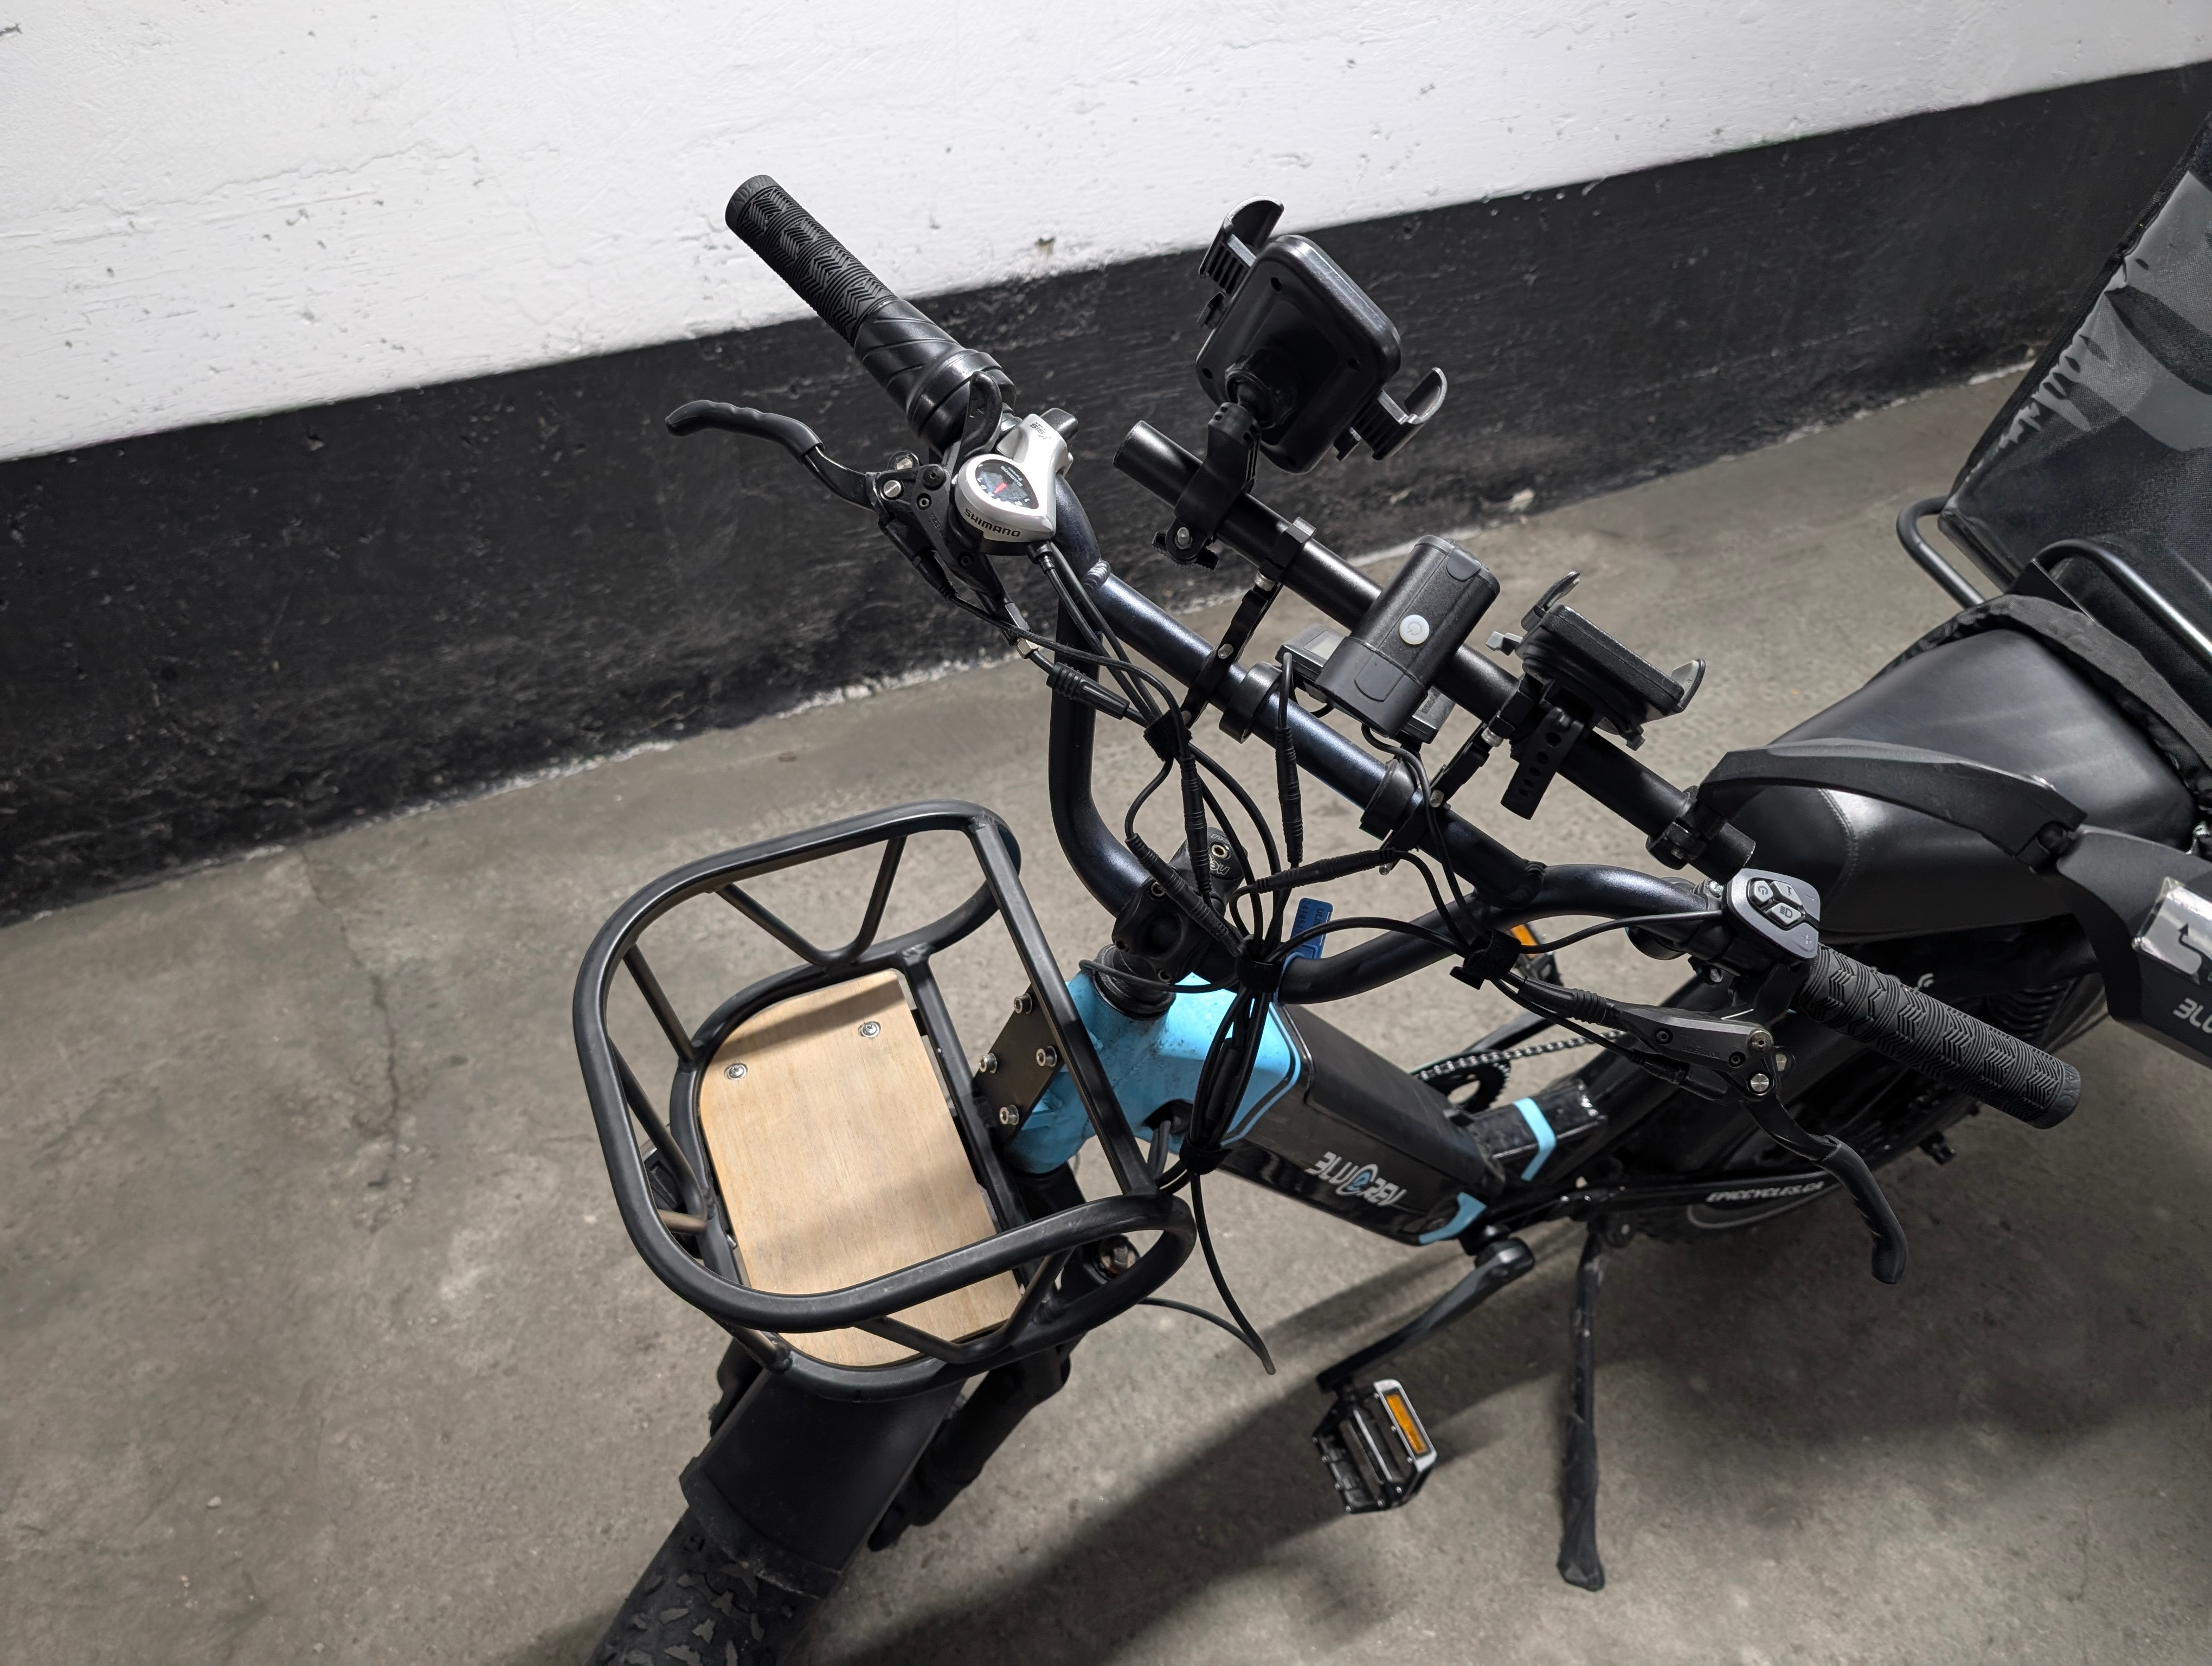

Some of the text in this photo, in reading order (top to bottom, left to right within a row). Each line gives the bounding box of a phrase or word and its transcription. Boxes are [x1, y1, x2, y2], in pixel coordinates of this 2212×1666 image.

[1030, 423, 1045, 434] SIS
[1000, 466, 1023, 487] SHIMANO
[964, 508, 1021, 537] SHIMANO
